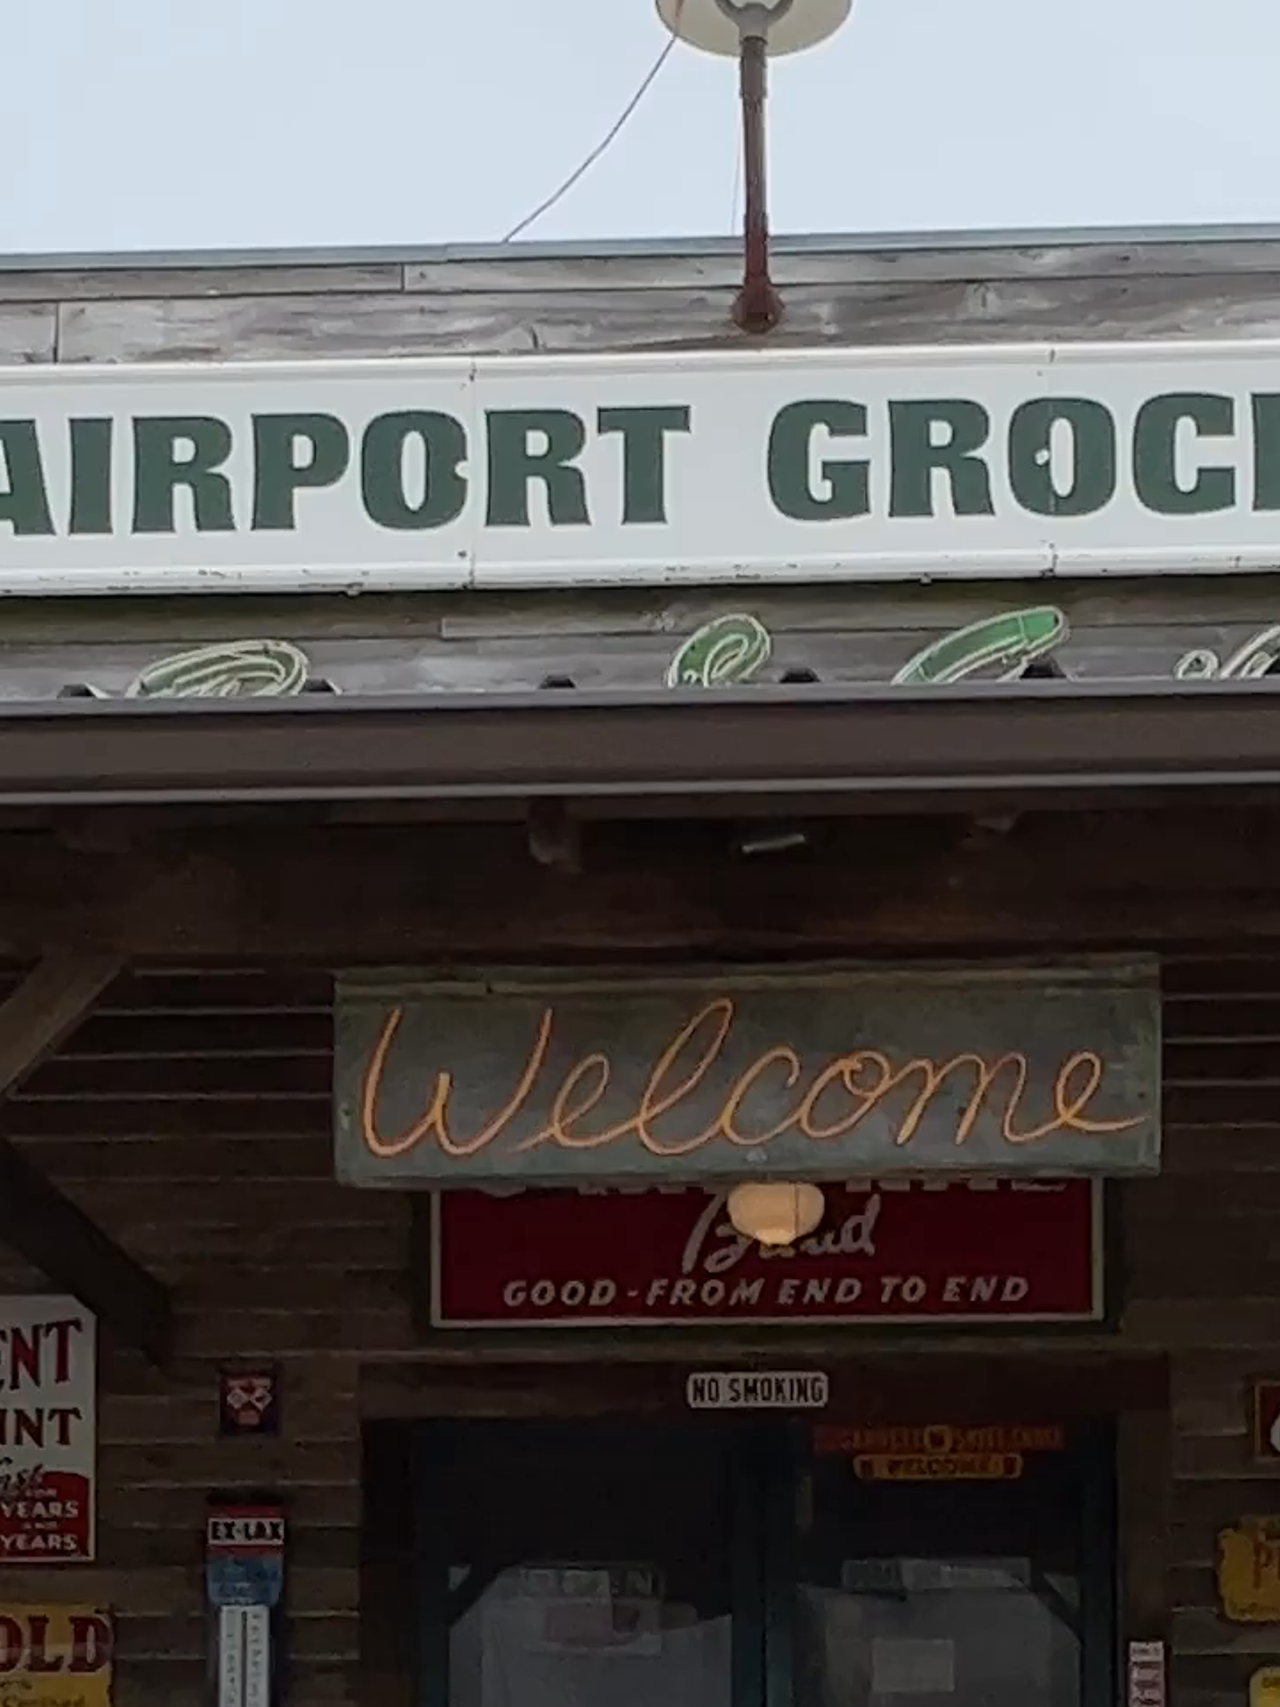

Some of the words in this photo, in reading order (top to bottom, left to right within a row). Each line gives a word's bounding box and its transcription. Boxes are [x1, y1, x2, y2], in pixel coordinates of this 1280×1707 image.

[360, 998, 1151, 1157] Welcome
[775, 1275, 863, 1304] END
[880, 1275, 928, 1302] TO
[941, 1274, 1030, 1303] END
[691, 1378, 719, 1401] NO
[729, 1377, 824, 1401] SMOKING
[0, 1500, 79, 1519] YEARS
[0, 1532, 79, 1551] YEARS
